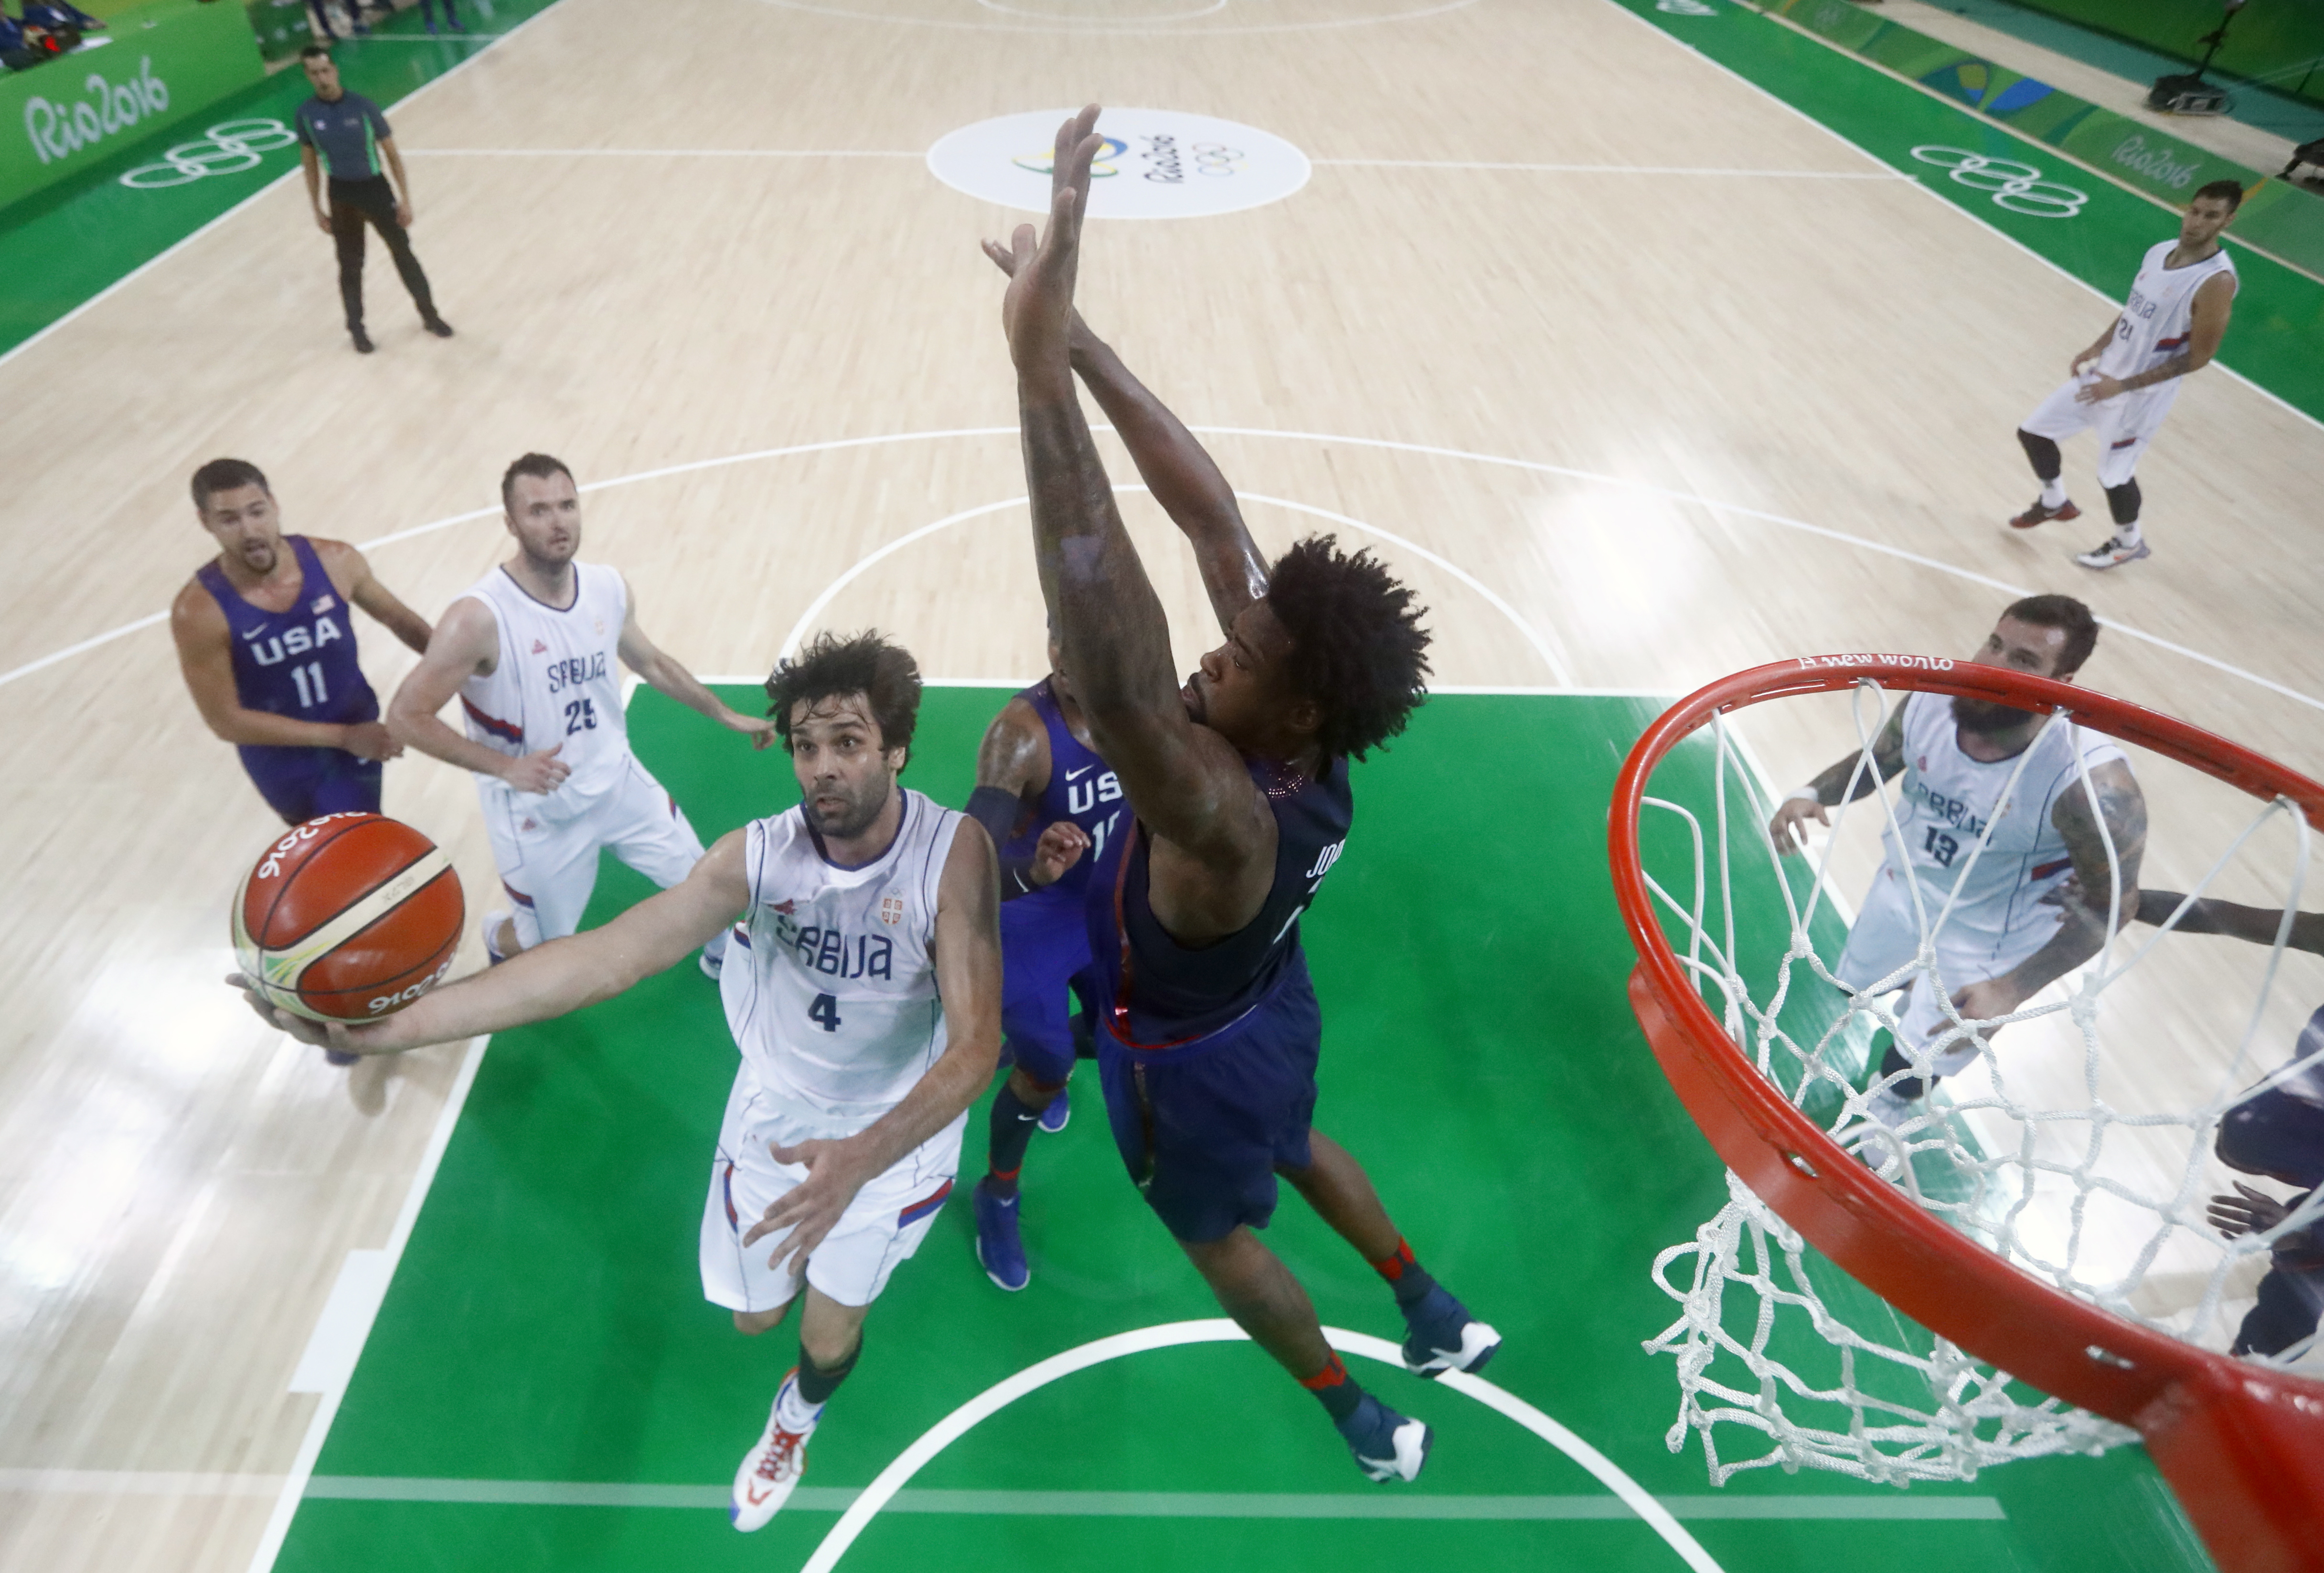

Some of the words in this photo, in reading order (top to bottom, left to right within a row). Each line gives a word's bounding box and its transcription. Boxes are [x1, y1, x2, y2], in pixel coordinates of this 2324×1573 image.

[24, 55, 170, 164] Rio2016
[1139, 134, 1185, 185] Rio2016
[2112, 135, 2200, 189] Rio2016
[2119, 318, 2133, 341] 21
[250, 616, 342, 666] USA
[1798, 657, 1817, 670] A
[1822, 653, 1873, 667] new
[1877, 653, 1954, 671] world
[291, 660, 329, 708] 11
[565, 698, 597, 736] 25
[1068, 771, 1123, 815] US
[1305, 838, 1347, 879] JOR
[1925, 825, 1959, 867] 13
[807, 992, 842, 1033] 4
